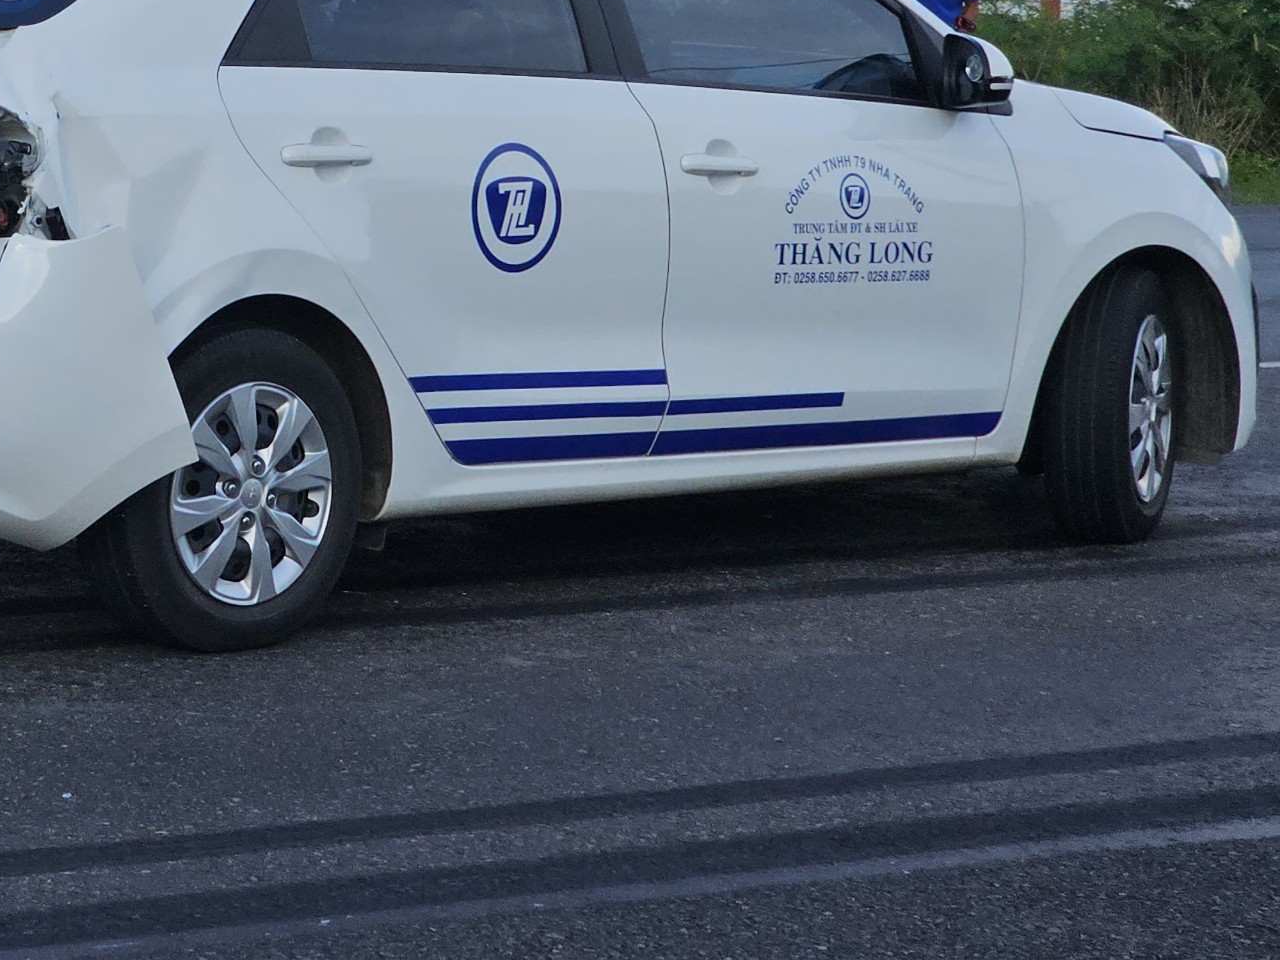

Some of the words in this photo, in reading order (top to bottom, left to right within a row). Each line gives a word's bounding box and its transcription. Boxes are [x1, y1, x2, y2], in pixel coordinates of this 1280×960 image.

[785, 178, 810, 214] CÔNG
[808, 165, 823, 182] TY
[822, 155, 851, 173] TNHH
[853, 155, 866, 169] 79
[869, 159, 890, 181] NHA
[893, 173, 924, 214] TRANG
[793, 223, 825, 234] TRUNG
[828, 220, 848, 234] TÂM
[850, 222, 863, 233] ĐT
[865, 223, 872, 233] &
[874, 222, 886, 233] SH
[906, 222, 919, 233] XE
[775, 237, 862, 266] THĂNG
[868, 241, 933, 264] LONG
[774, 272, 791, 284] ĐT:
[794, 271, 859, 284] 0258.650.6677
